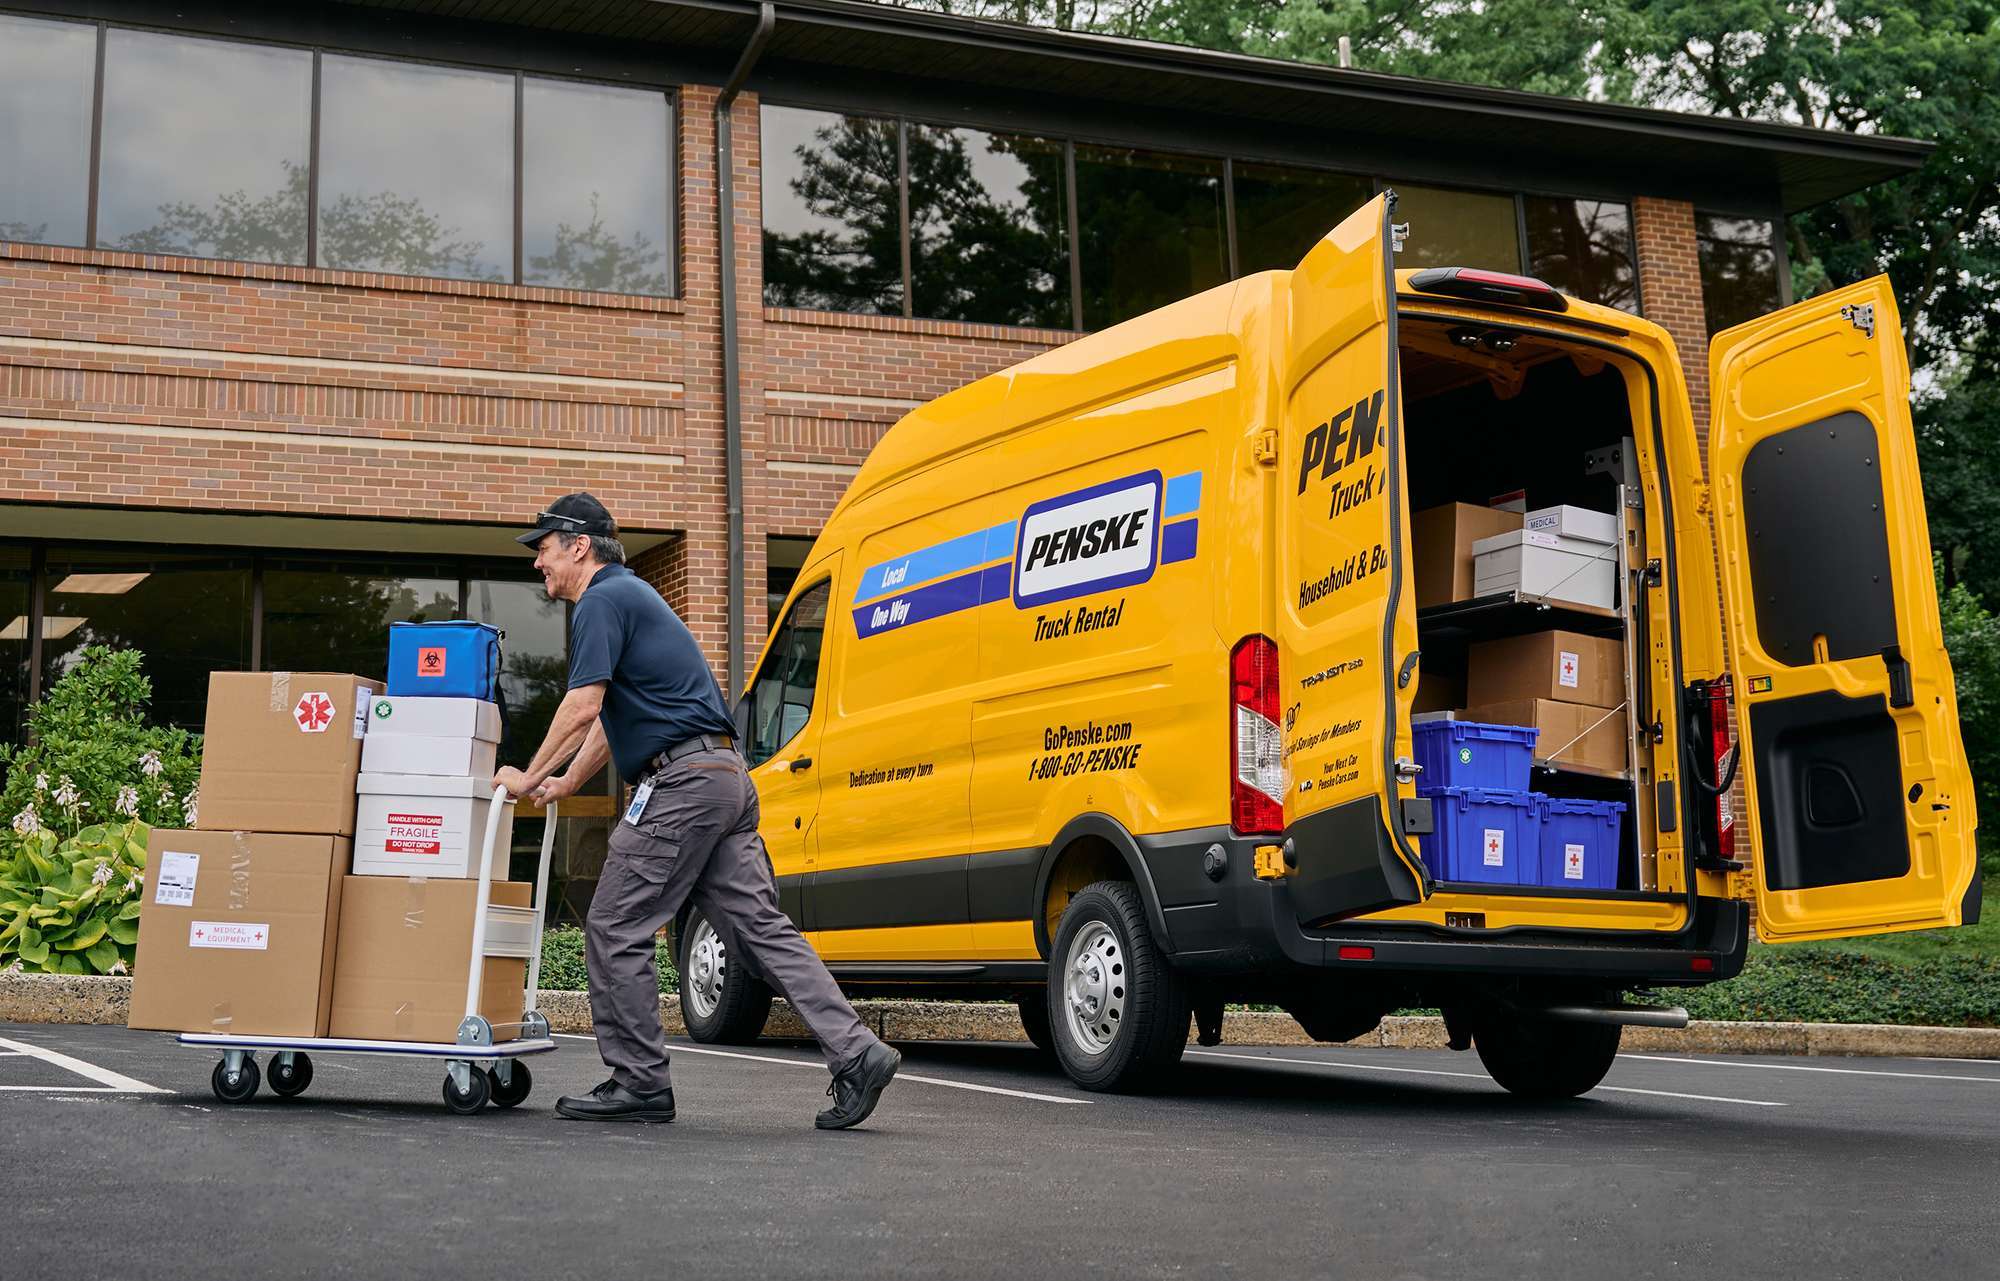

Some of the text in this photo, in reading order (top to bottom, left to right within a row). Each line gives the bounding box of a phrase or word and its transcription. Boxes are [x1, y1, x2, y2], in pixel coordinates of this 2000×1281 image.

[1329, 464, 1376, 520] Truck
[1530, 517, 1556, 528] MEDICAL
[1025, 508, 1149, 572] PENSKE
[882, 560, 910, 588] Local
[1299, 555, 1356, 610] Household
[1356, 550, 1367, 580] &
[871, 600, 911, 628] One Way
[1034, 598, 1125, 642] Truck Rental
[1301, 662, 1347, 689] TRANSIT
[1044, 721, 1132, 751] GoPenske.com
[1296, 733, 1320, 752] Savings
[1319, 728, 1331, 743] for
[1330, 720, 1362, 739] Members
[850, 763, 934, 788] Dedication at every turn.
[1028, 744, 1142, 781] 1-800-GO-PENSKE
[1323, 754, 1358, 774] Your Next Car
[390, 827, 439, 838] FRAGILE
[207, 936, 252, 944] EQUIPMENT
